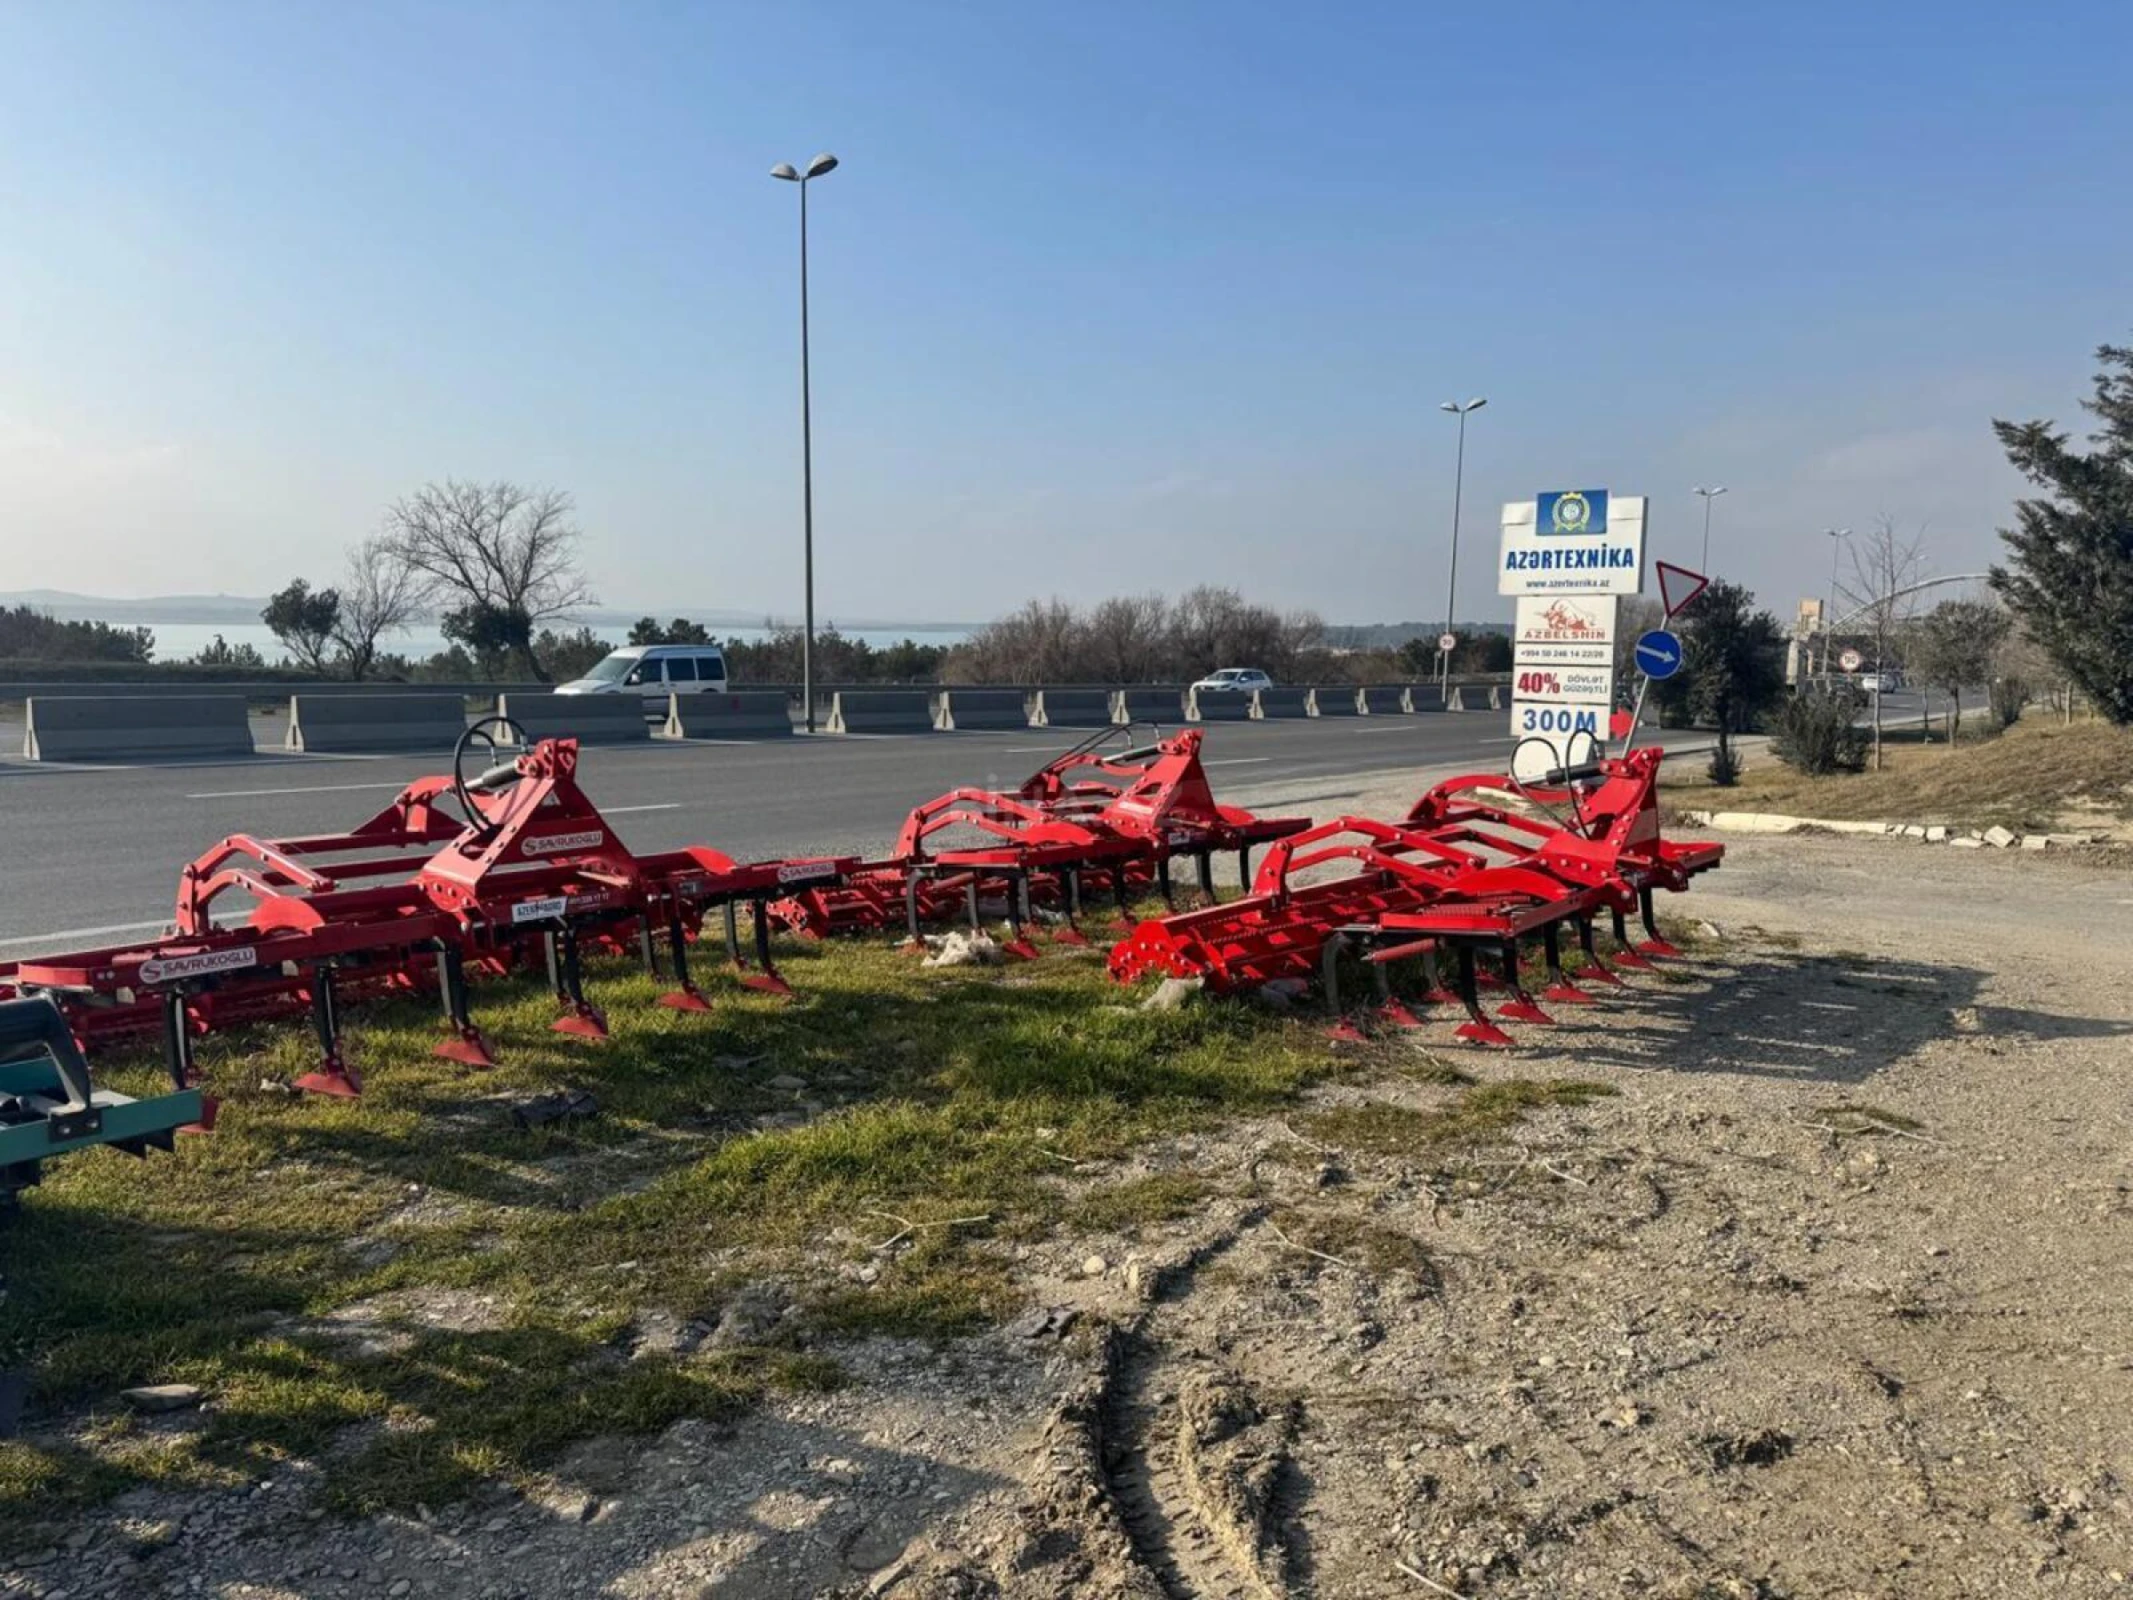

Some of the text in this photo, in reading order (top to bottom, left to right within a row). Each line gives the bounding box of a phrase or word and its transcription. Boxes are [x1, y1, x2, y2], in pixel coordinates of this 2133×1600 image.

[1506, 542, 1634, 570] AZƏRTEXNİKA
[1524, 631, 1605, 639] AZBELSHIN
[1518, 671, 1560, 694] 40%
[1523, 709, 1597, 733] 300M
